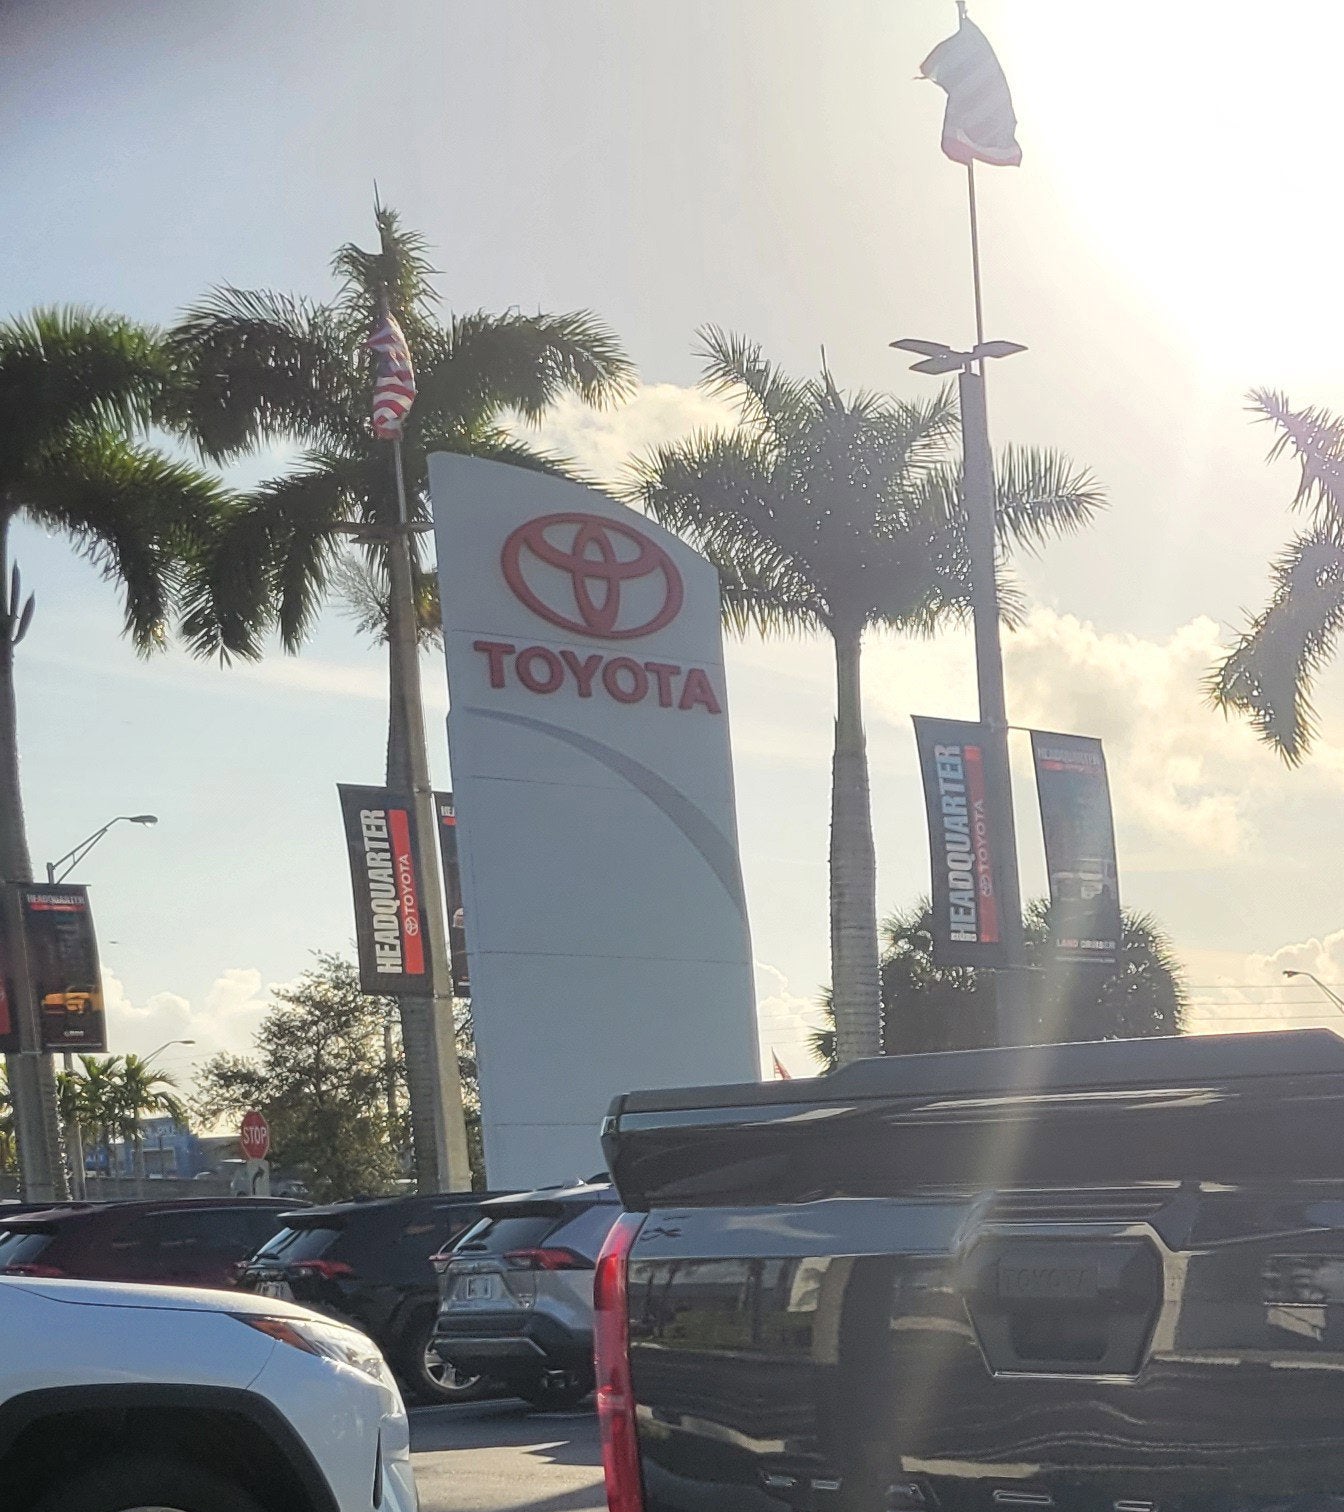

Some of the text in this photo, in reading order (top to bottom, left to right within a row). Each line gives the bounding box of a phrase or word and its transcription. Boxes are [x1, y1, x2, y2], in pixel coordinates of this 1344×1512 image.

[473, 640, 722, 714] TOYOTA
[934, 744, 978, 942] HEADQUARTER
[974, 799, 993, 873] TOYOTA
[360, 809, 403, 974] HEADQUARTER
[399, 853, 416, 915] TOYOTA
[243, 1126, 268, 1145] STOP
